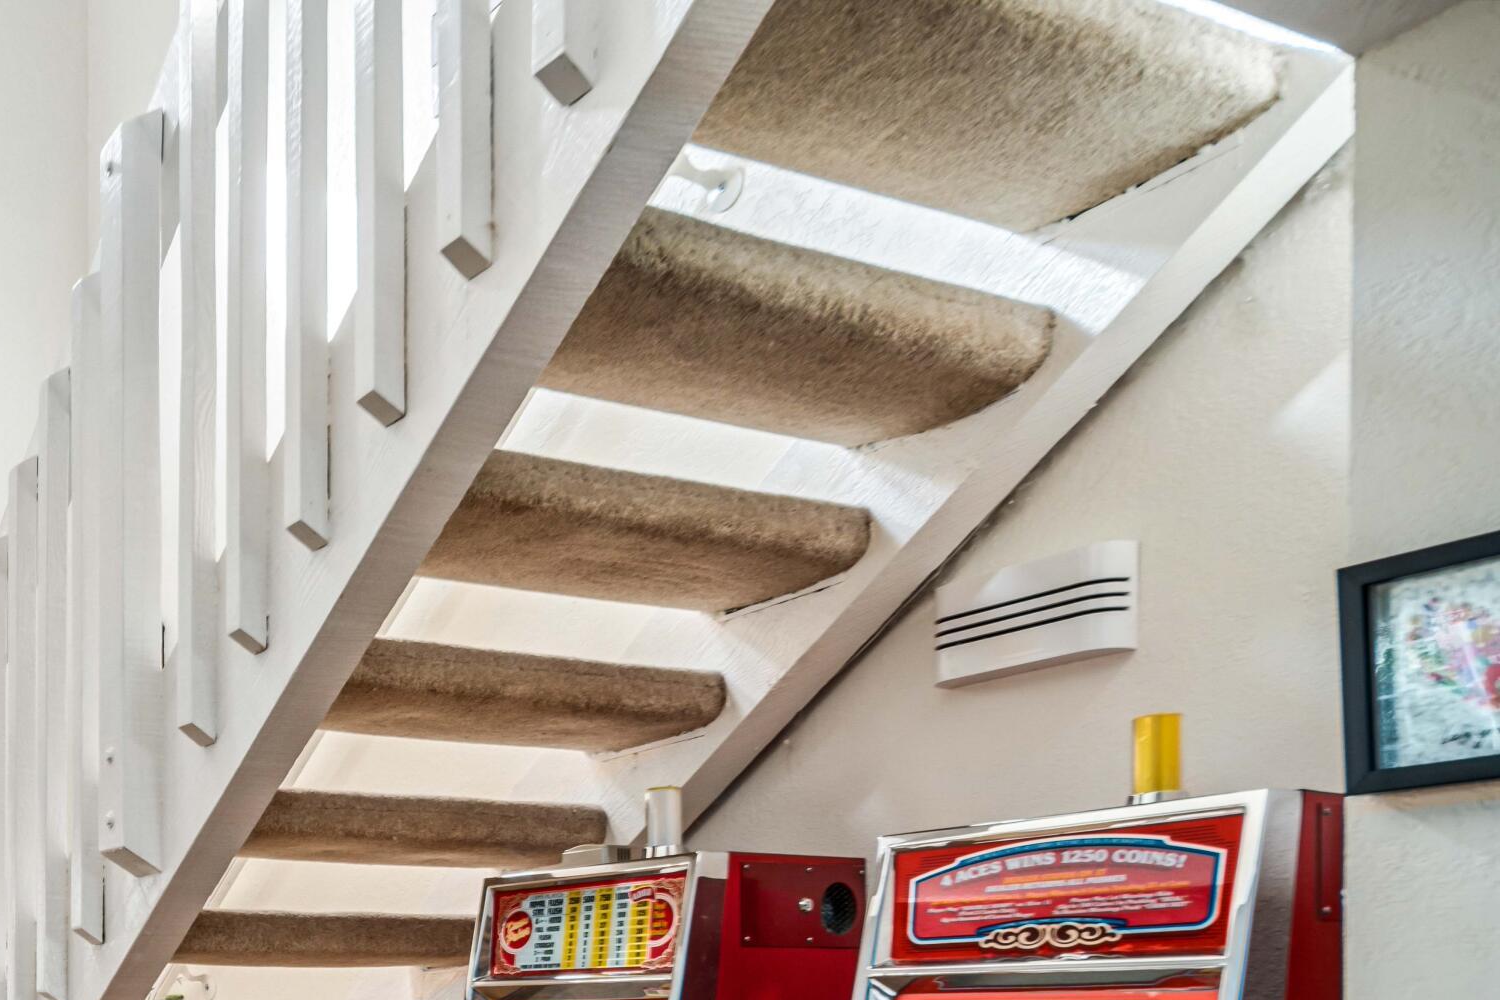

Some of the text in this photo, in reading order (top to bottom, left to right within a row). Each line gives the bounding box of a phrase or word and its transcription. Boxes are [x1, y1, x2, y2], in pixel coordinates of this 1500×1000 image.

[954, 861, 1003, 883] ACES
[1005, 852, 1057, 871] WINS
[1060, 848, 1109, 864] 1250
[1111, 849, 1188, 869] COINS!
